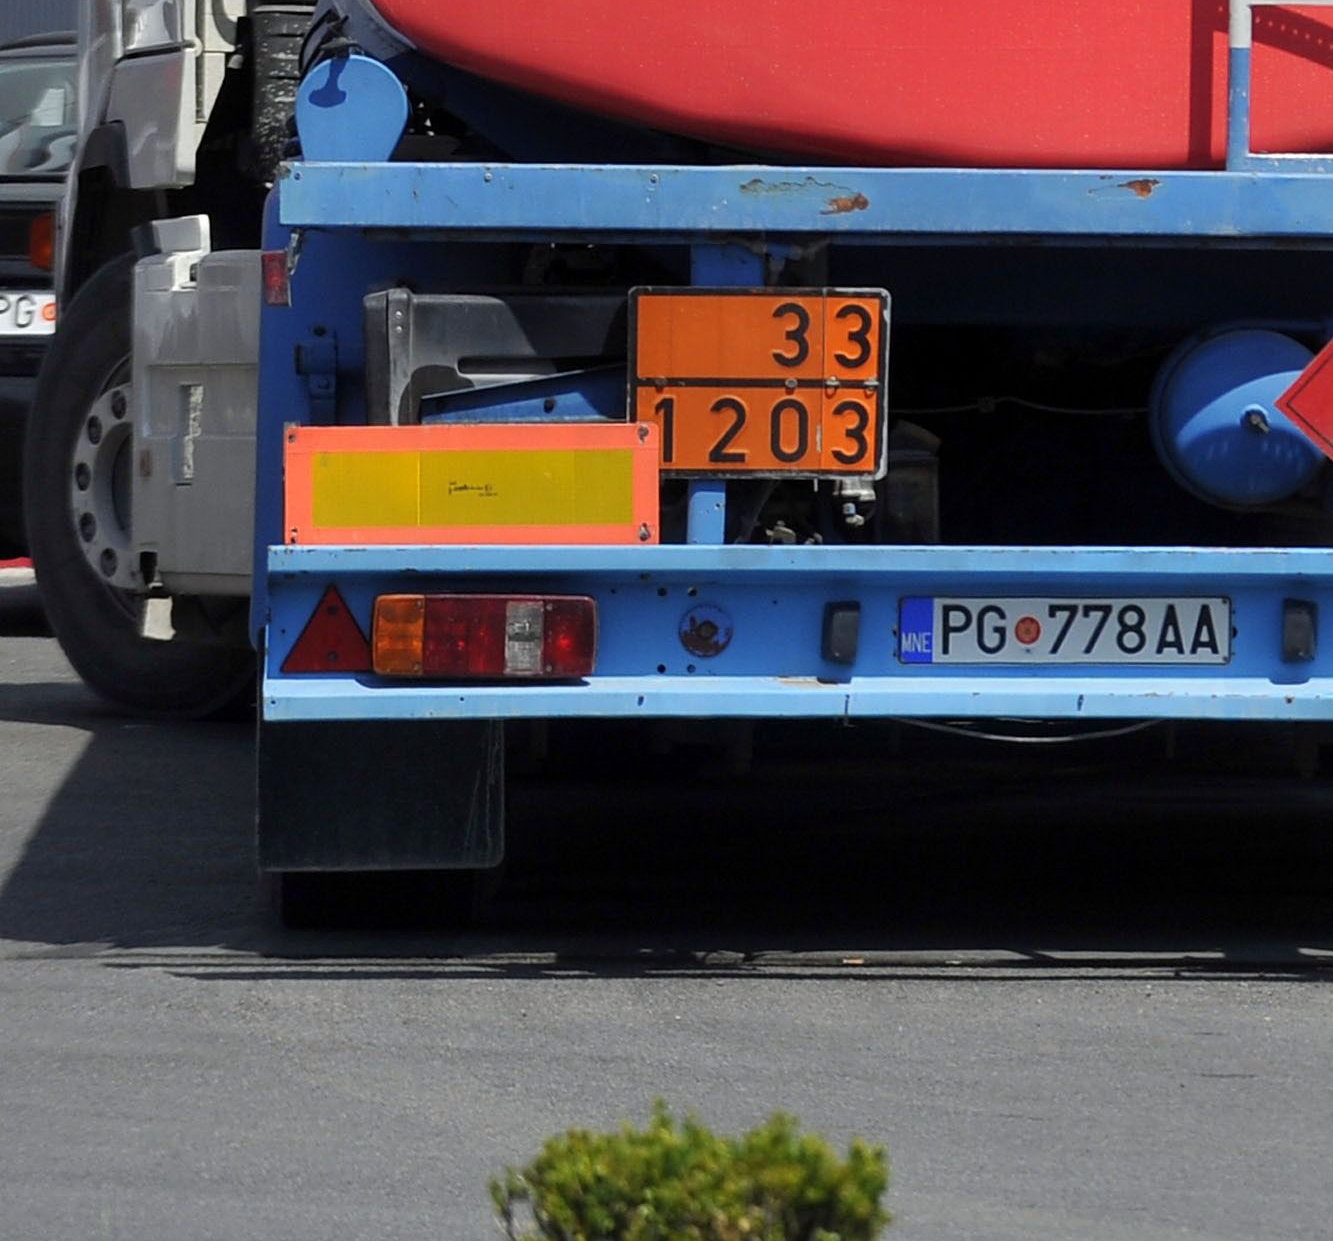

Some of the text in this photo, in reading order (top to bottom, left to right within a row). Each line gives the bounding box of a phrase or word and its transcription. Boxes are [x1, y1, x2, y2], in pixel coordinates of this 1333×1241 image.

[654, 397, 869, 465] 1203
[901, 632, 932, 654] MNE
[942, 604, 1007, 654] PG
